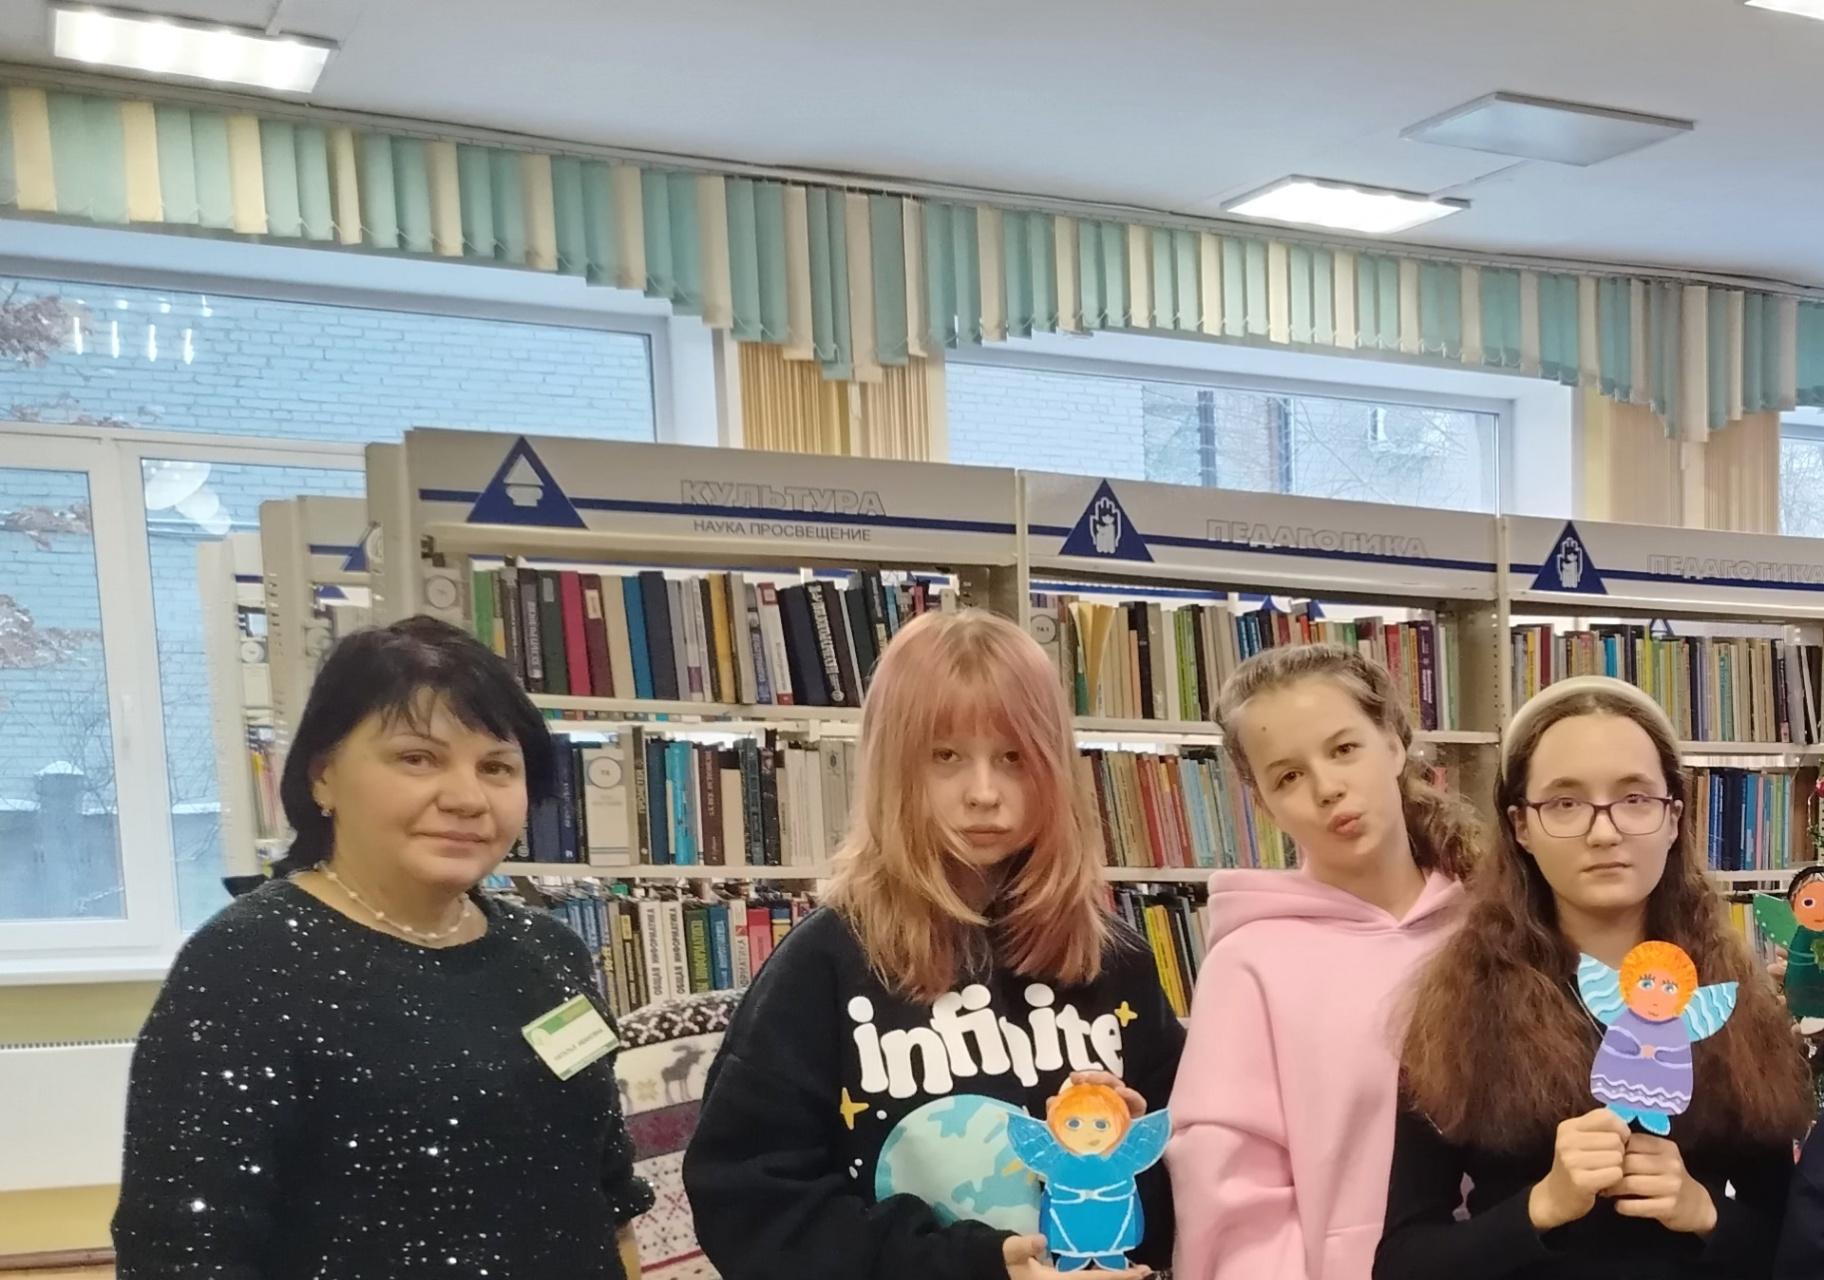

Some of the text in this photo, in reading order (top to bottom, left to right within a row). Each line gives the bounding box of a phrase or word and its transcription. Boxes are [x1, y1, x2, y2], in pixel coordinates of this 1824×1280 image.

[680, 479, 887, 516] КУЛЬТУРА
[693, 518, 872, 542] НАУКА ПРОСВЕЩЕНИЕ
[1206, 519, 1428, 558] ПЕДАГОГИКА
[848, 983, 1123, 1098] infinite
